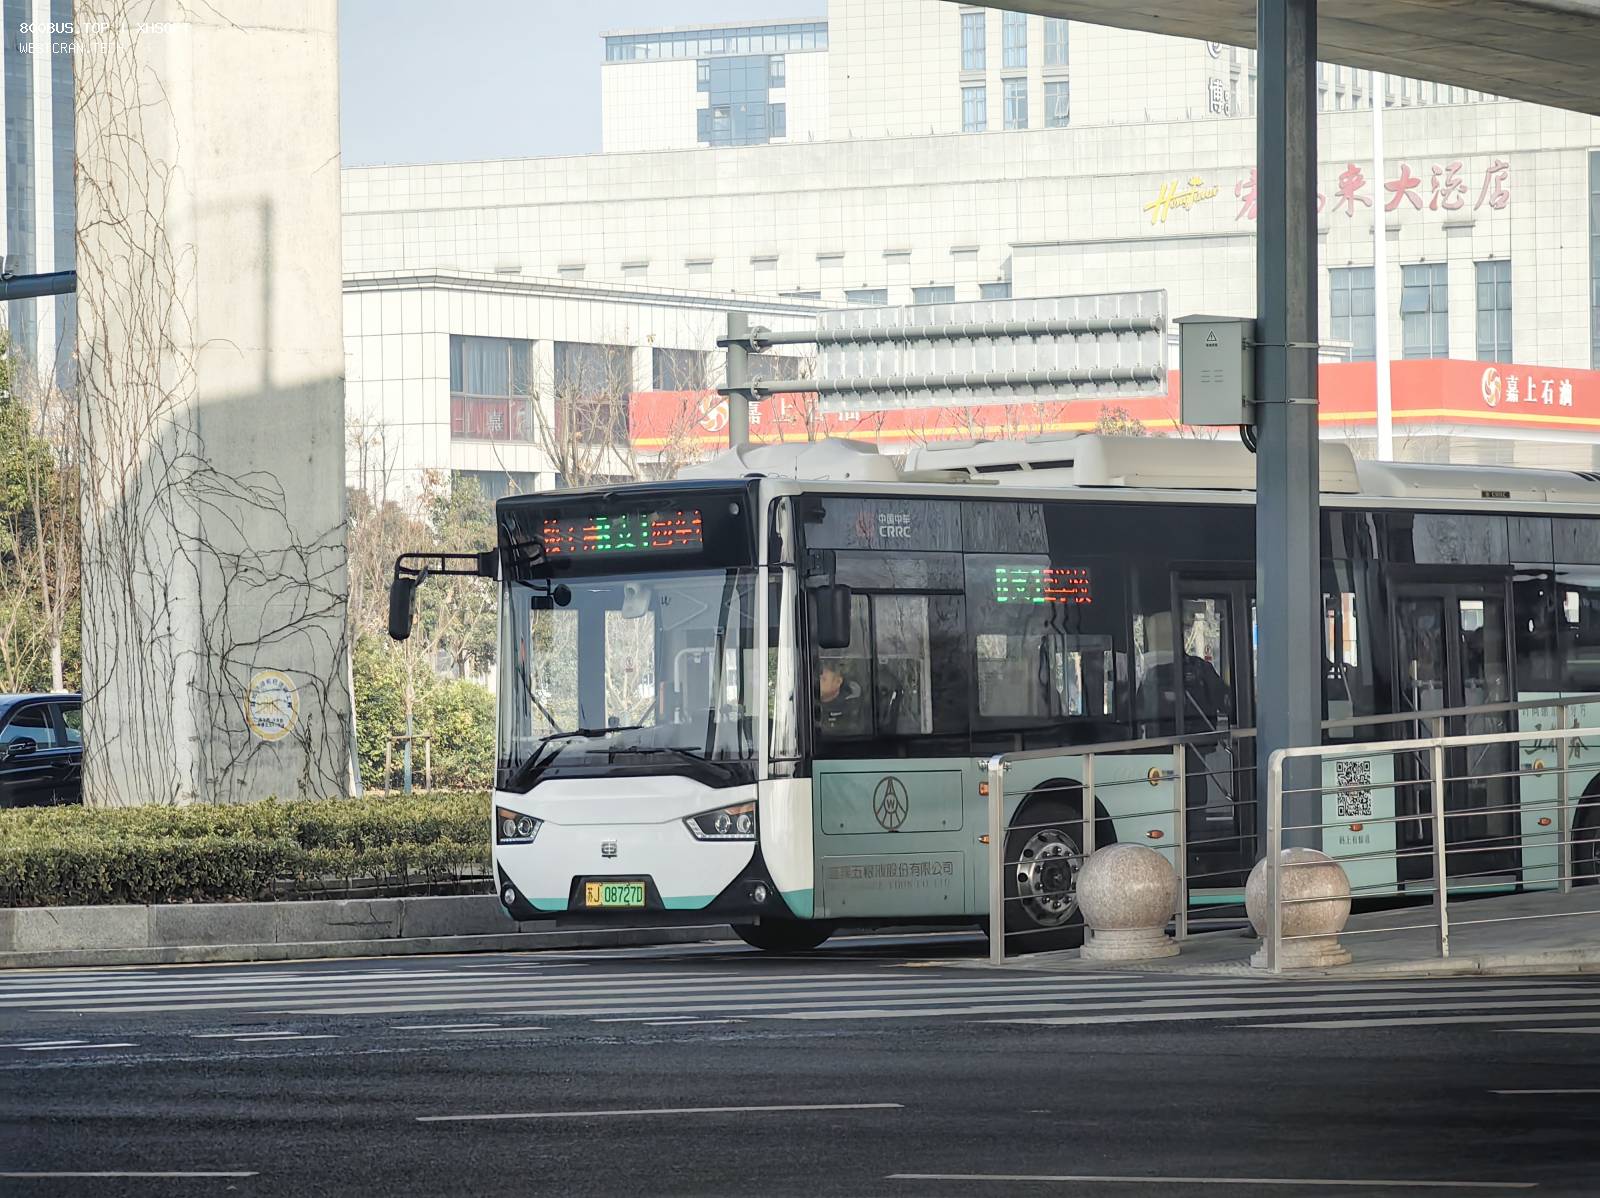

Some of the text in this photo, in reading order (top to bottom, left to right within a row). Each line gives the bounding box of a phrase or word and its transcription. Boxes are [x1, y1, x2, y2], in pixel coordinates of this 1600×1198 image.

[1505, 375, 1572, 407] 嘉上石油
[879, 513, 911, 525] 中国中车
[879, 526, 911, 538] CRRC
[604, 886, 643, 903] 08727D
